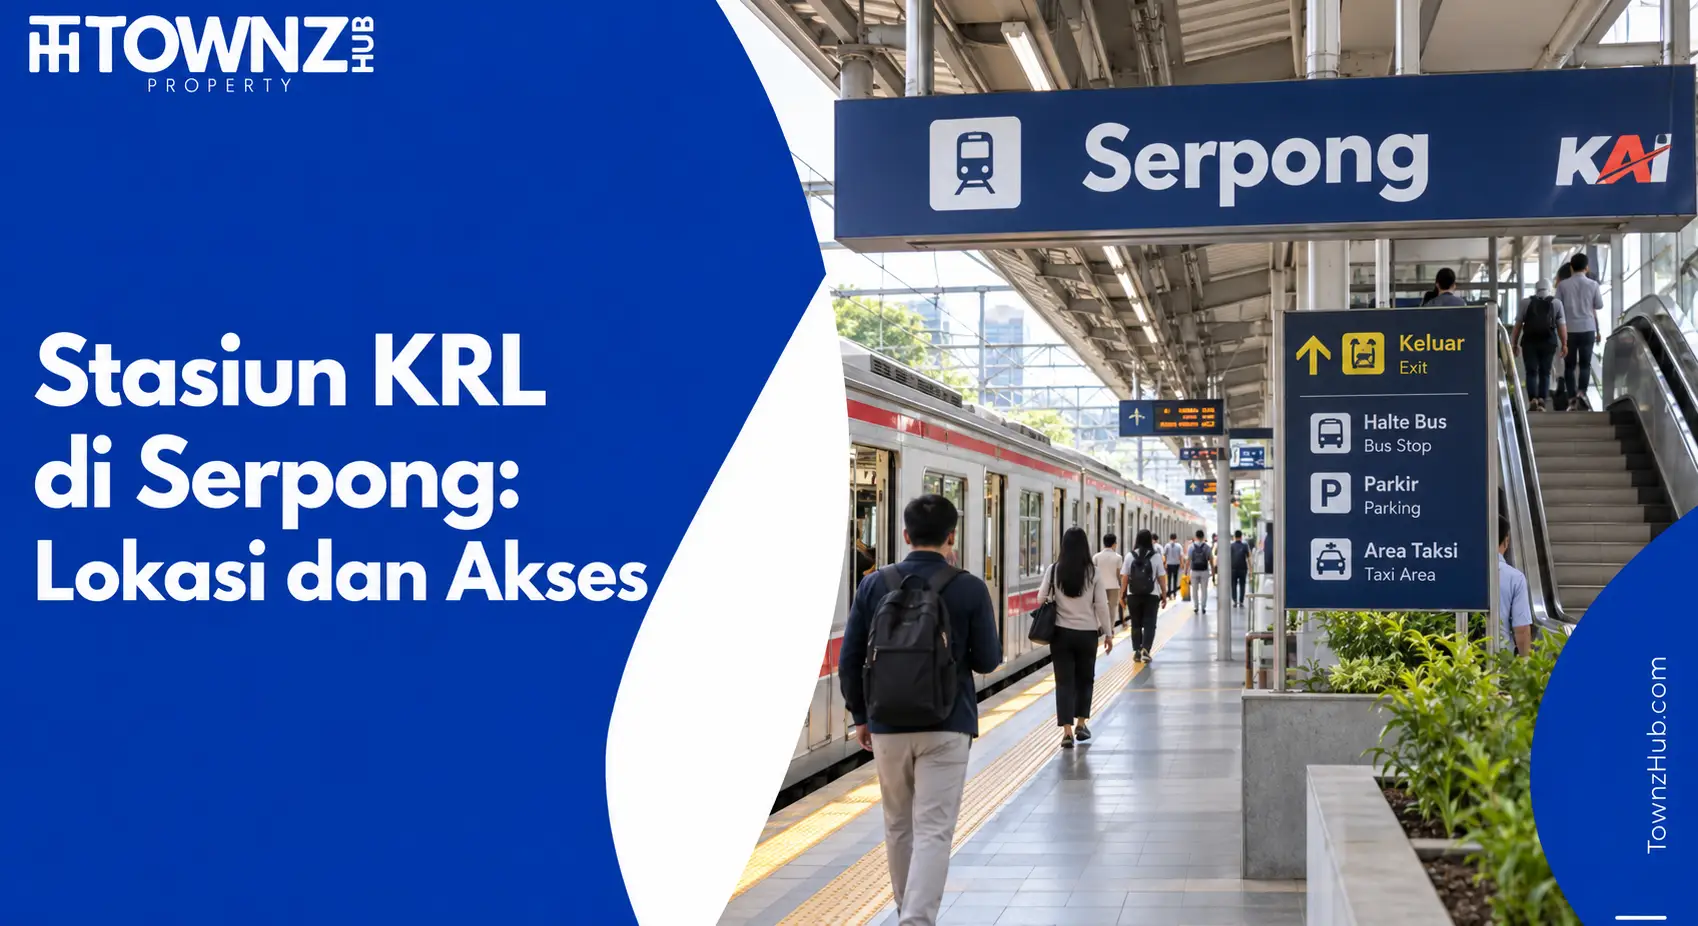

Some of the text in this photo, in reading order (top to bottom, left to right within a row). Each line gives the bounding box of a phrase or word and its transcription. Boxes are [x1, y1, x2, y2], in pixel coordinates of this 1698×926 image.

[1083, 122, 1428, 207] Serpong
[1399, 333, 1465, 352] Keluar
[1400, 360, 1428, 375] Exit
[1364, 413, 1447, 430] Halte Bus
[1364, 438, 1432, 456] Bus Stop
[1364, 475, 1419, 492] Parkir
[1321, 479, 1342, 507] P
[1364, 500, 1421, 519] Parking
[1364, 541, 1458, 559] Area Taksi
[1364, 566, 1436, 582] Taxi Area
